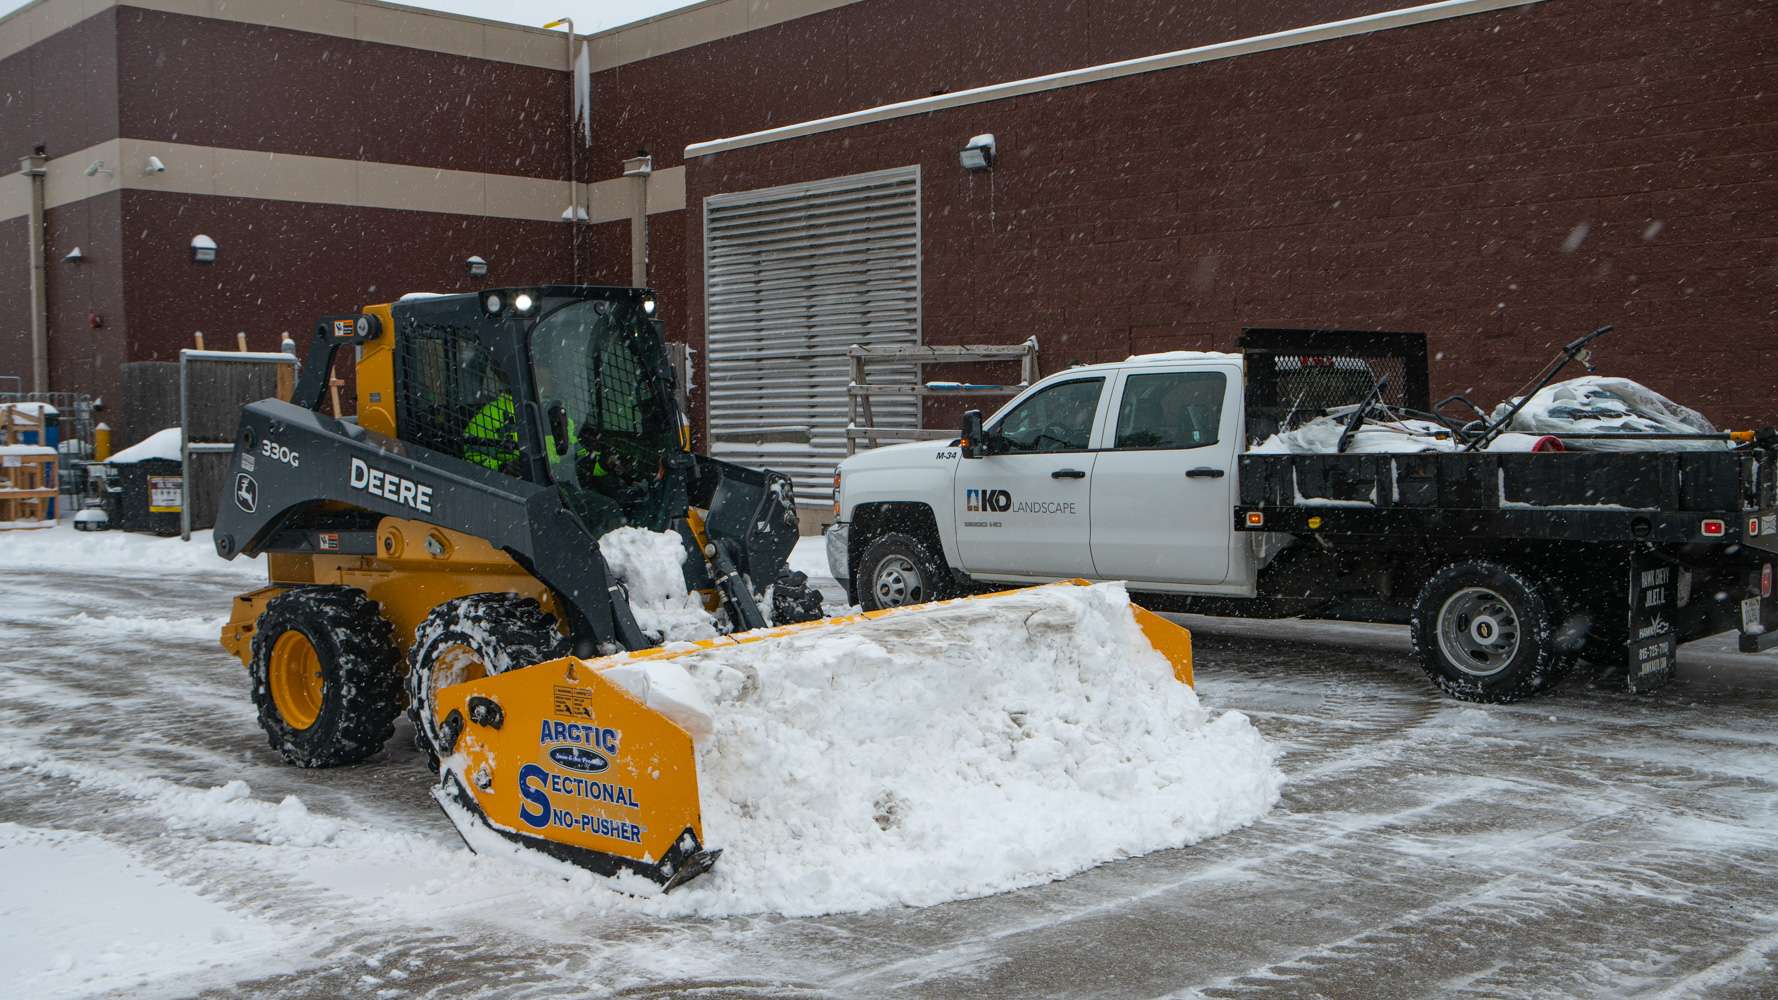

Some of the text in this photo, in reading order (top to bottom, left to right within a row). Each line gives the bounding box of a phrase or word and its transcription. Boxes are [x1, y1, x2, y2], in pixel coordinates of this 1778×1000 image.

[261, 439, 299, 467] 330G
[936, 451, 957, 460] M-34
[350, 457, 433, 513] DEERE
[981, 489, 1076, 514] KD LANDSCAPE
[540, 719, 618, 755] ARCTIC
